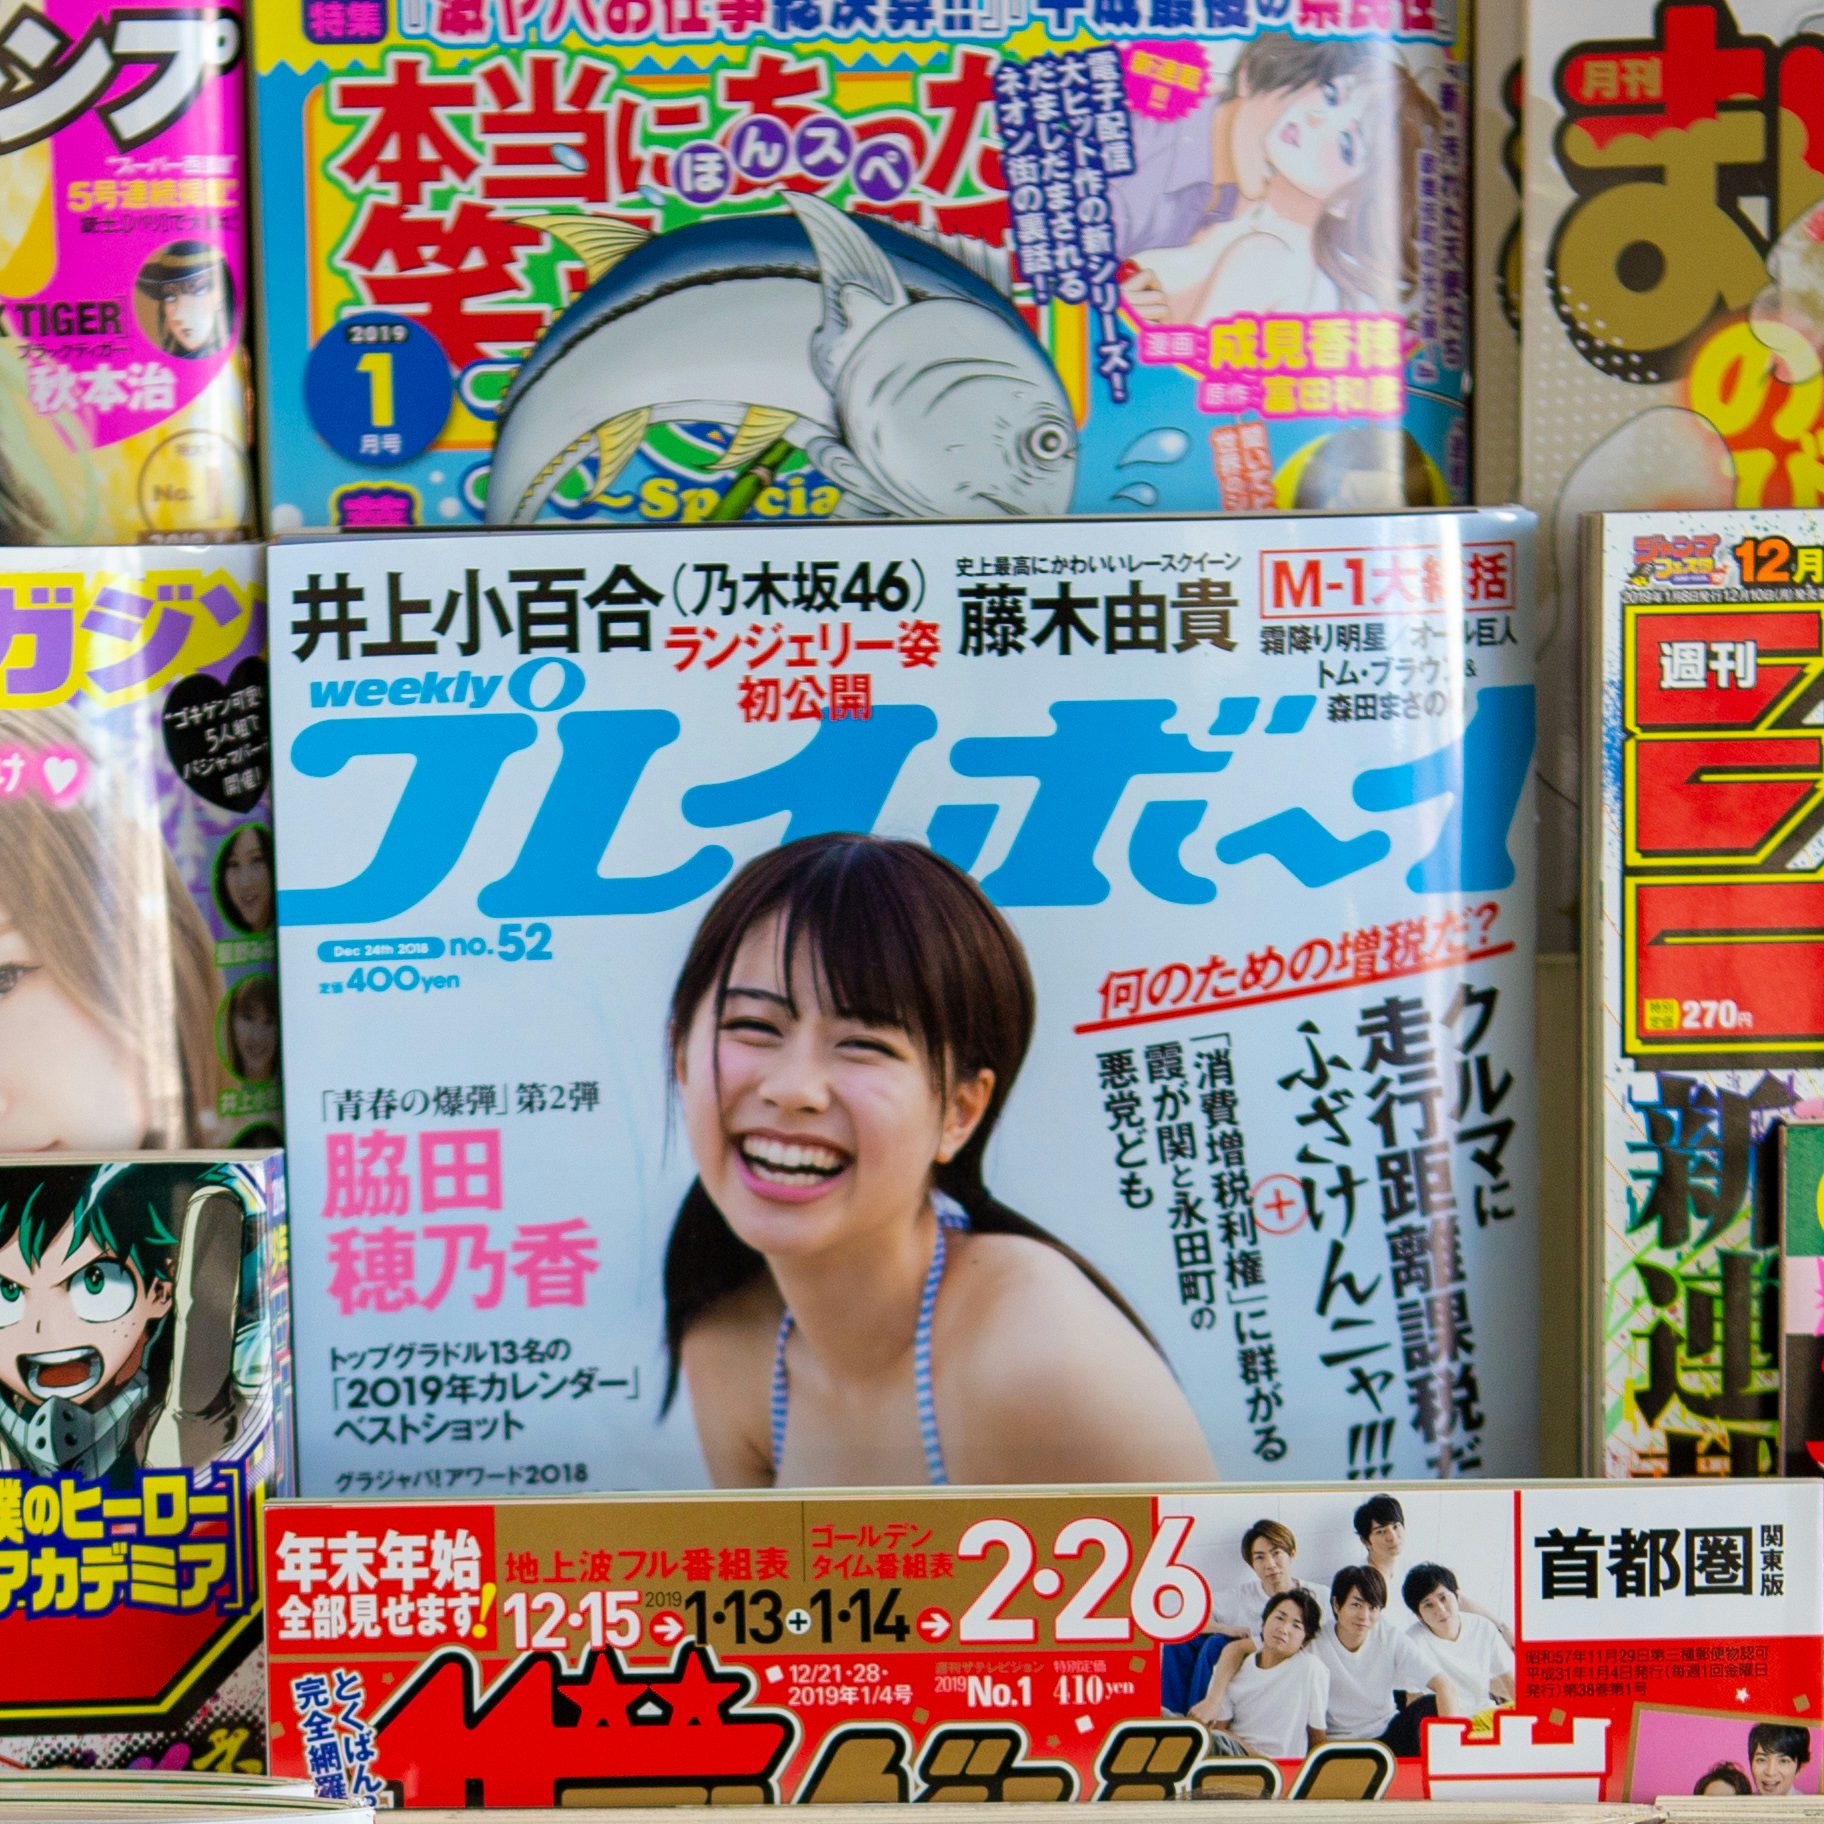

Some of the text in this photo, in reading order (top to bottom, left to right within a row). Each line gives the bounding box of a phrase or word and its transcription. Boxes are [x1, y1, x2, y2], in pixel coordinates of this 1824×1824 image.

[1580, 57, 1664, 101] 月刊
[16, 303, 123, 340] TIGER
[956, 551, 1243, 577] 史上最高にかわいいレースクイーン
[290, 563, 666, 662] 井上小百合
[956, 577, 1241, 657] 藤木由貴
[663, 619, 942, 672] ランジェリー姿
[1658, 639, 1758, 690] 週刊
[309, 670, 506, 710] weekly
[737, 674, 873, 724] 初公開
[449, 922, 553, 962] no.52
[1438, 980, 1517, 1228] クルマに
[1095, 1047, 1155, 1212] 悪党ども
[322, 1126, 505, 1221] 脇田
[1144, 1040, 1217, 1332] 霞が関と永田町の
[326, 1216, 602, 1316] 穂乃香
[329, 1337, 572, 1372] トップグラドル13名の
[334, 1409, 525, 1447] ベストショット
[810, 1522, 934, 1550] ゴールデン
[1759, 1522, 1786, 1600] 関東版
[276, 1529, 483, 1594] 年末年始
[502, 1546, 791, 1584] 地上波フル番組表
[810, 1551, 955, 1581] タイム番組表
[1533, 1525, 1757, 1601] 首都圏
[966, 1675, 1034, 1709] No.1
